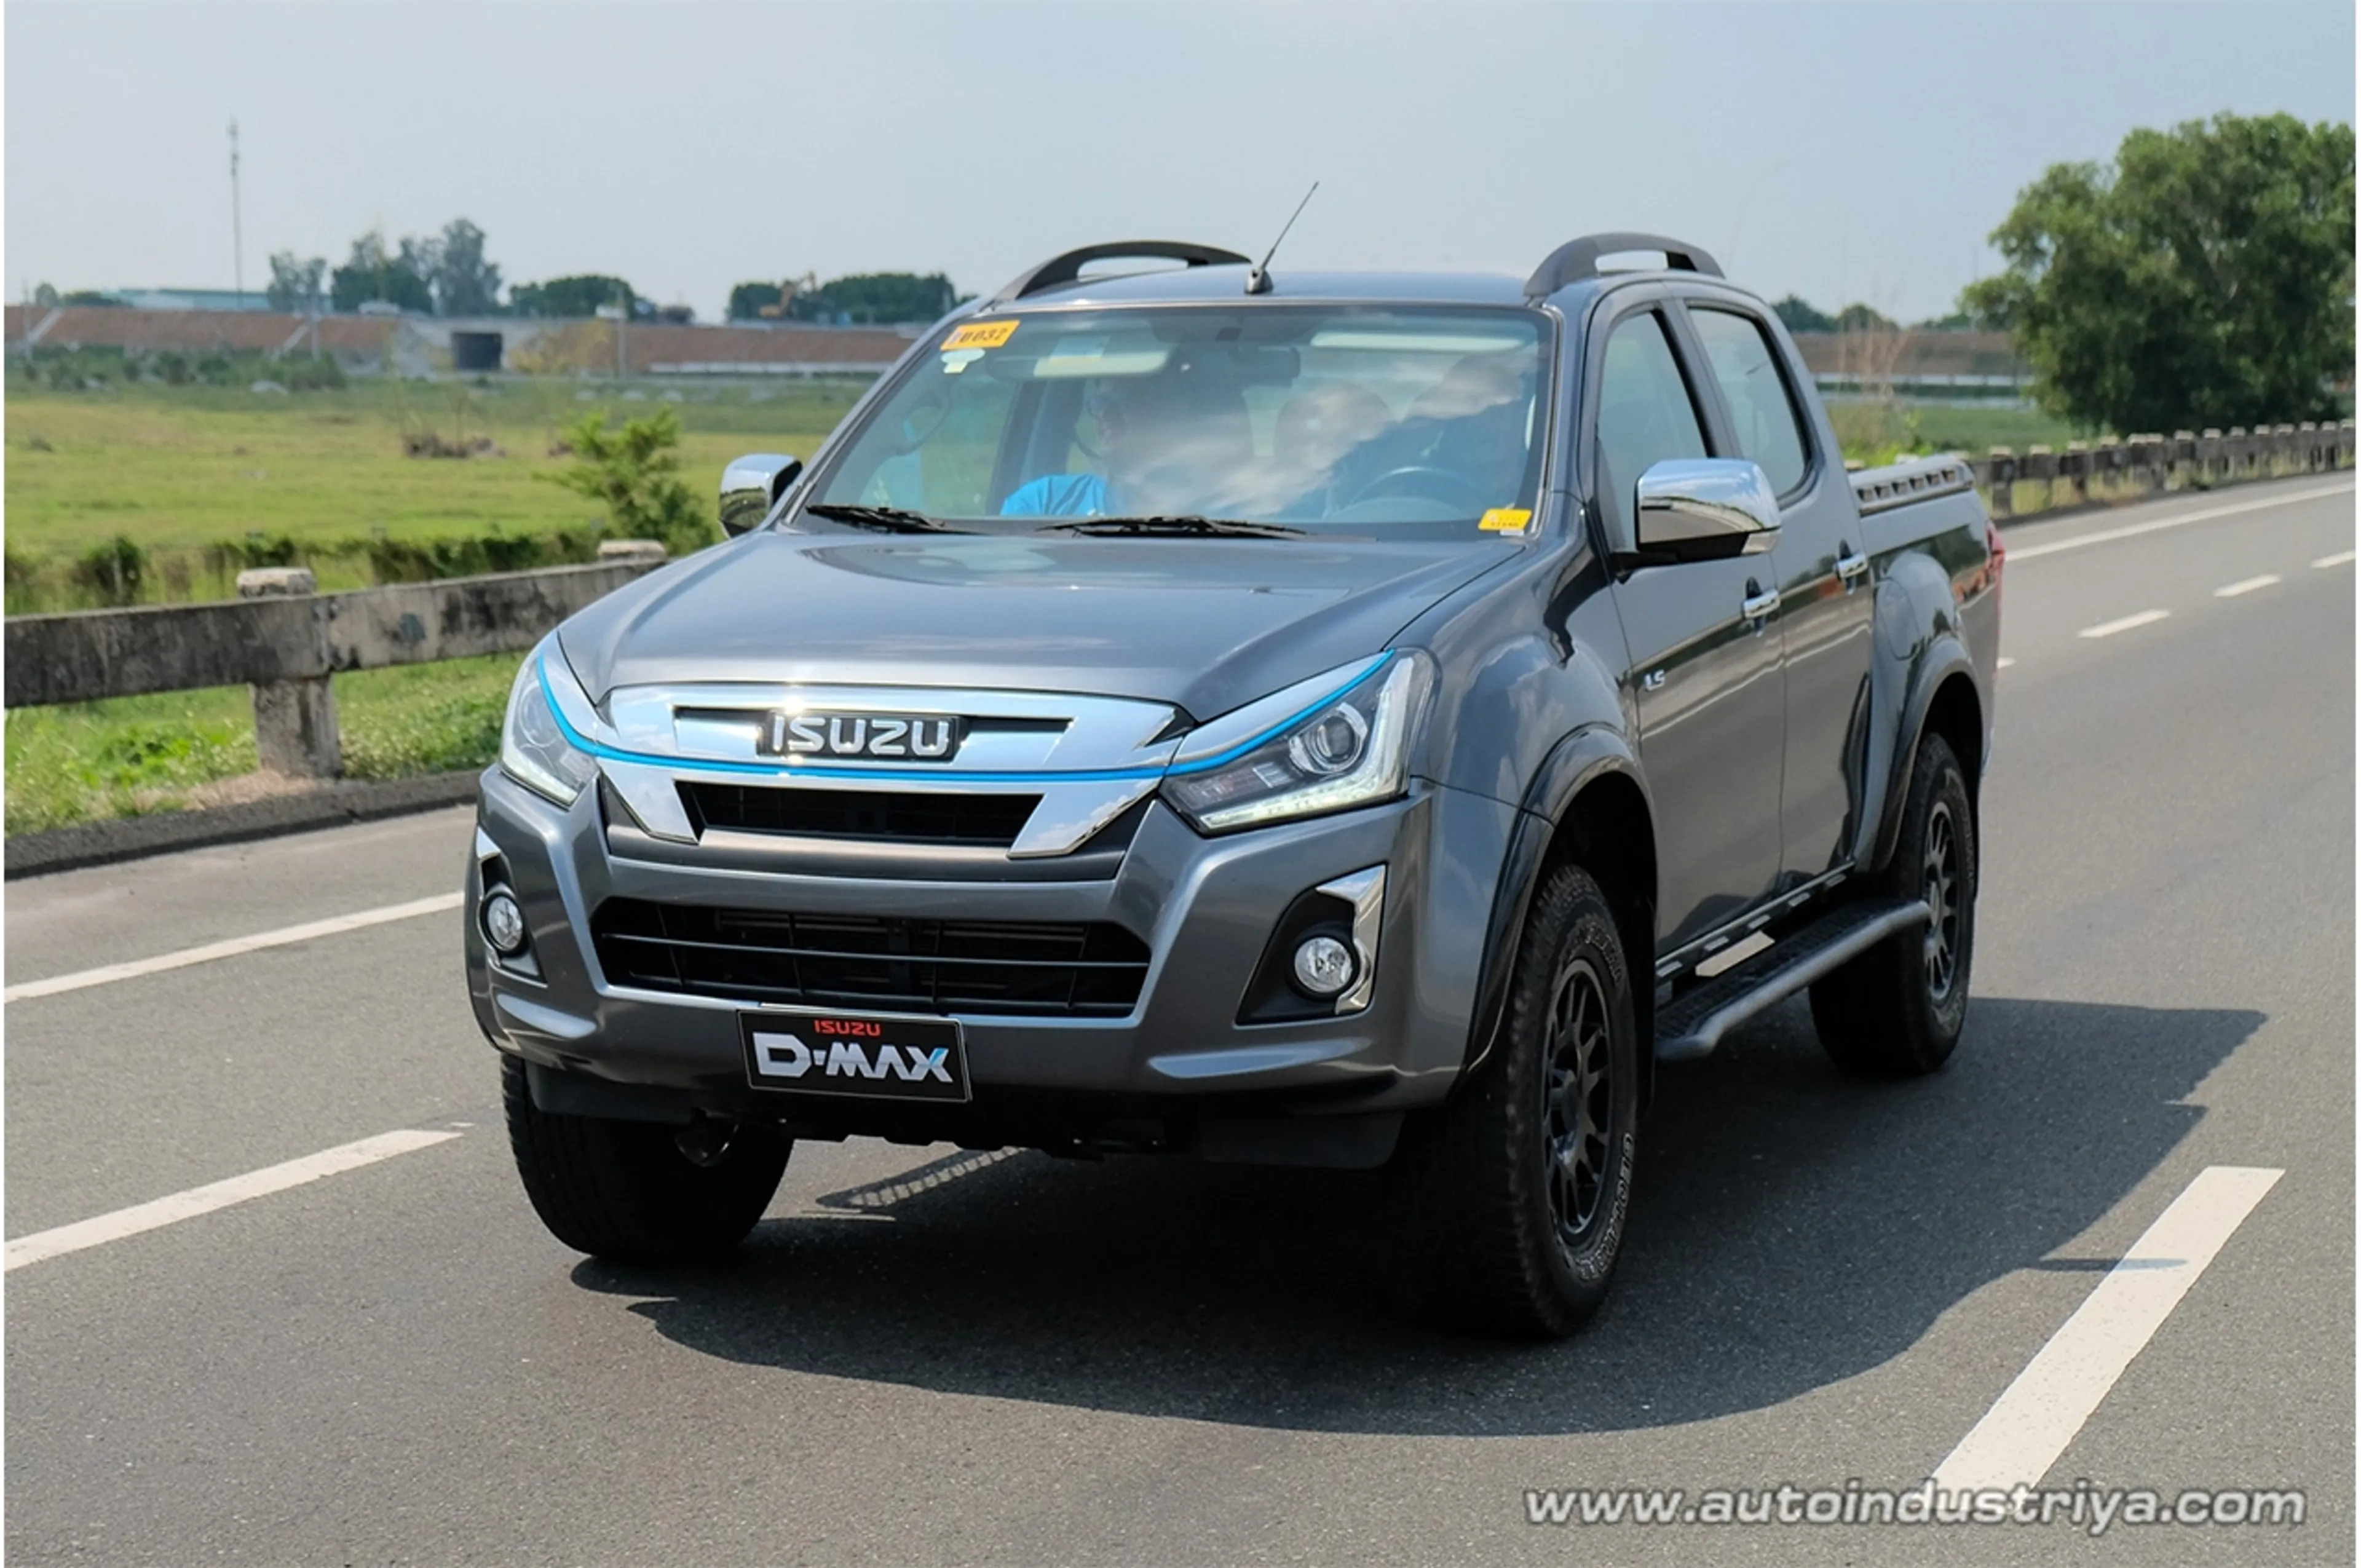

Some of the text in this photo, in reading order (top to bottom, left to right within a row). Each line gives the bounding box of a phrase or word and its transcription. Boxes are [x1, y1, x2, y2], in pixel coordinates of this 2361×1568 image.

[772, 715, 949, 757] ISUZU
[813, 1019, 881, 1037] ISUZU
[752, 1031, 954, 1083] D-MAX
